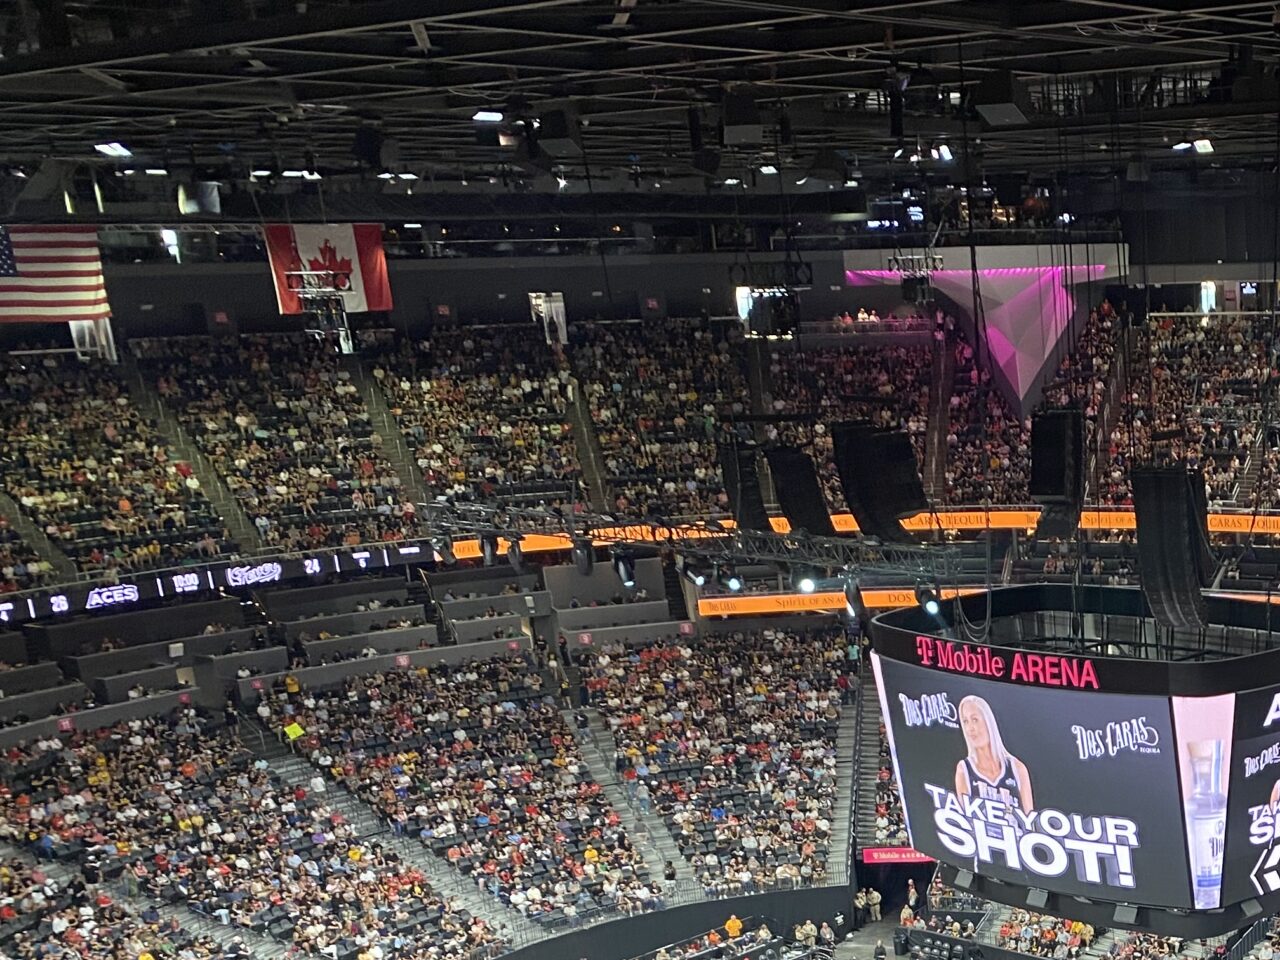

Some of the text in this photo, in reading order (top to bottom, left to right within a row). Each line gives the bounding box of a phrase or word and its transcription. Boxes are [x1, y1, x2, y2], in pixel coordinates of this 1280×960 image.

[1210, 517, 1241, 528] CARAS
[91, 586, 138, 606] ACES
[888, 593, 915, 603] DOS
[936, 640, 1004, 677] Mobile
[1011, 653, 1099, 689] ARENA
[1105, 716, 1159, 757] CARAS
[924, 782, 1008, 827] TAKE
[1014, 808, 1140, 847] YOUR
[934, 808, 1137, 888] SHOT!
